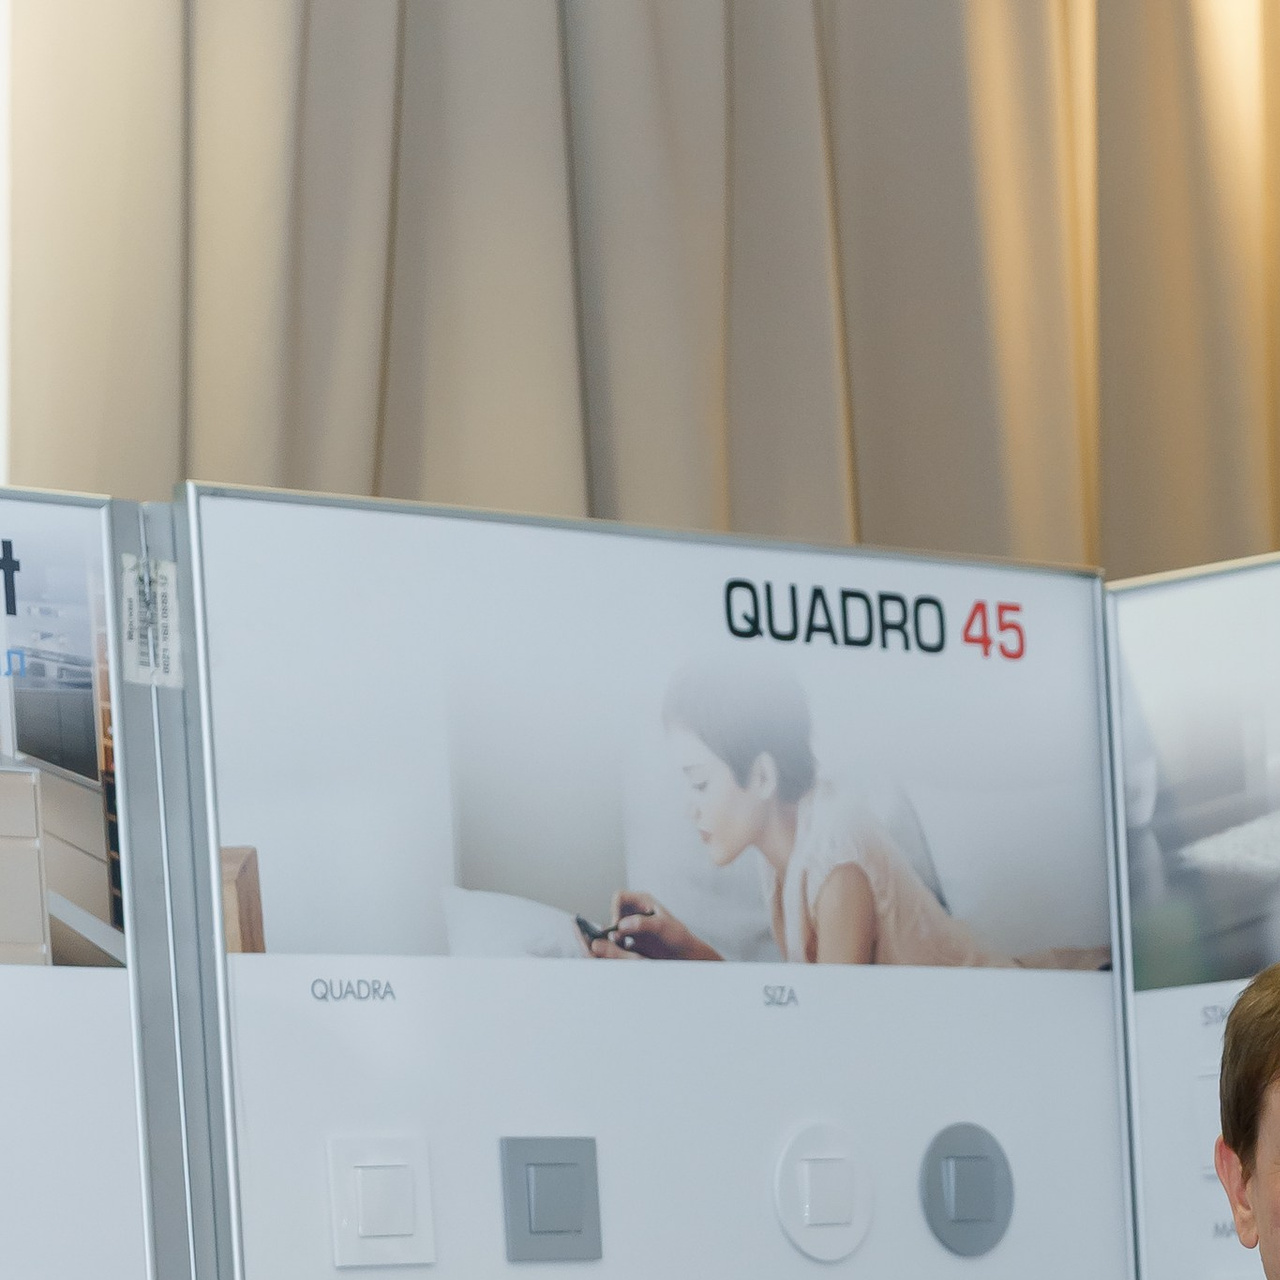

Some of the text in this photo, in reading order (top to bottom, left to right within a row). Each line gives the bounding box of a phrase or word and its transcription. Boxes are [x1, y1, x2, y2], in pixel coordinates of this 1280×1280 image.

[724, 577, 1025, 660] QUADRO 45
[311, 978, 396, 1002] QUADRA
[763, 984, 799, 1006] SIZA
